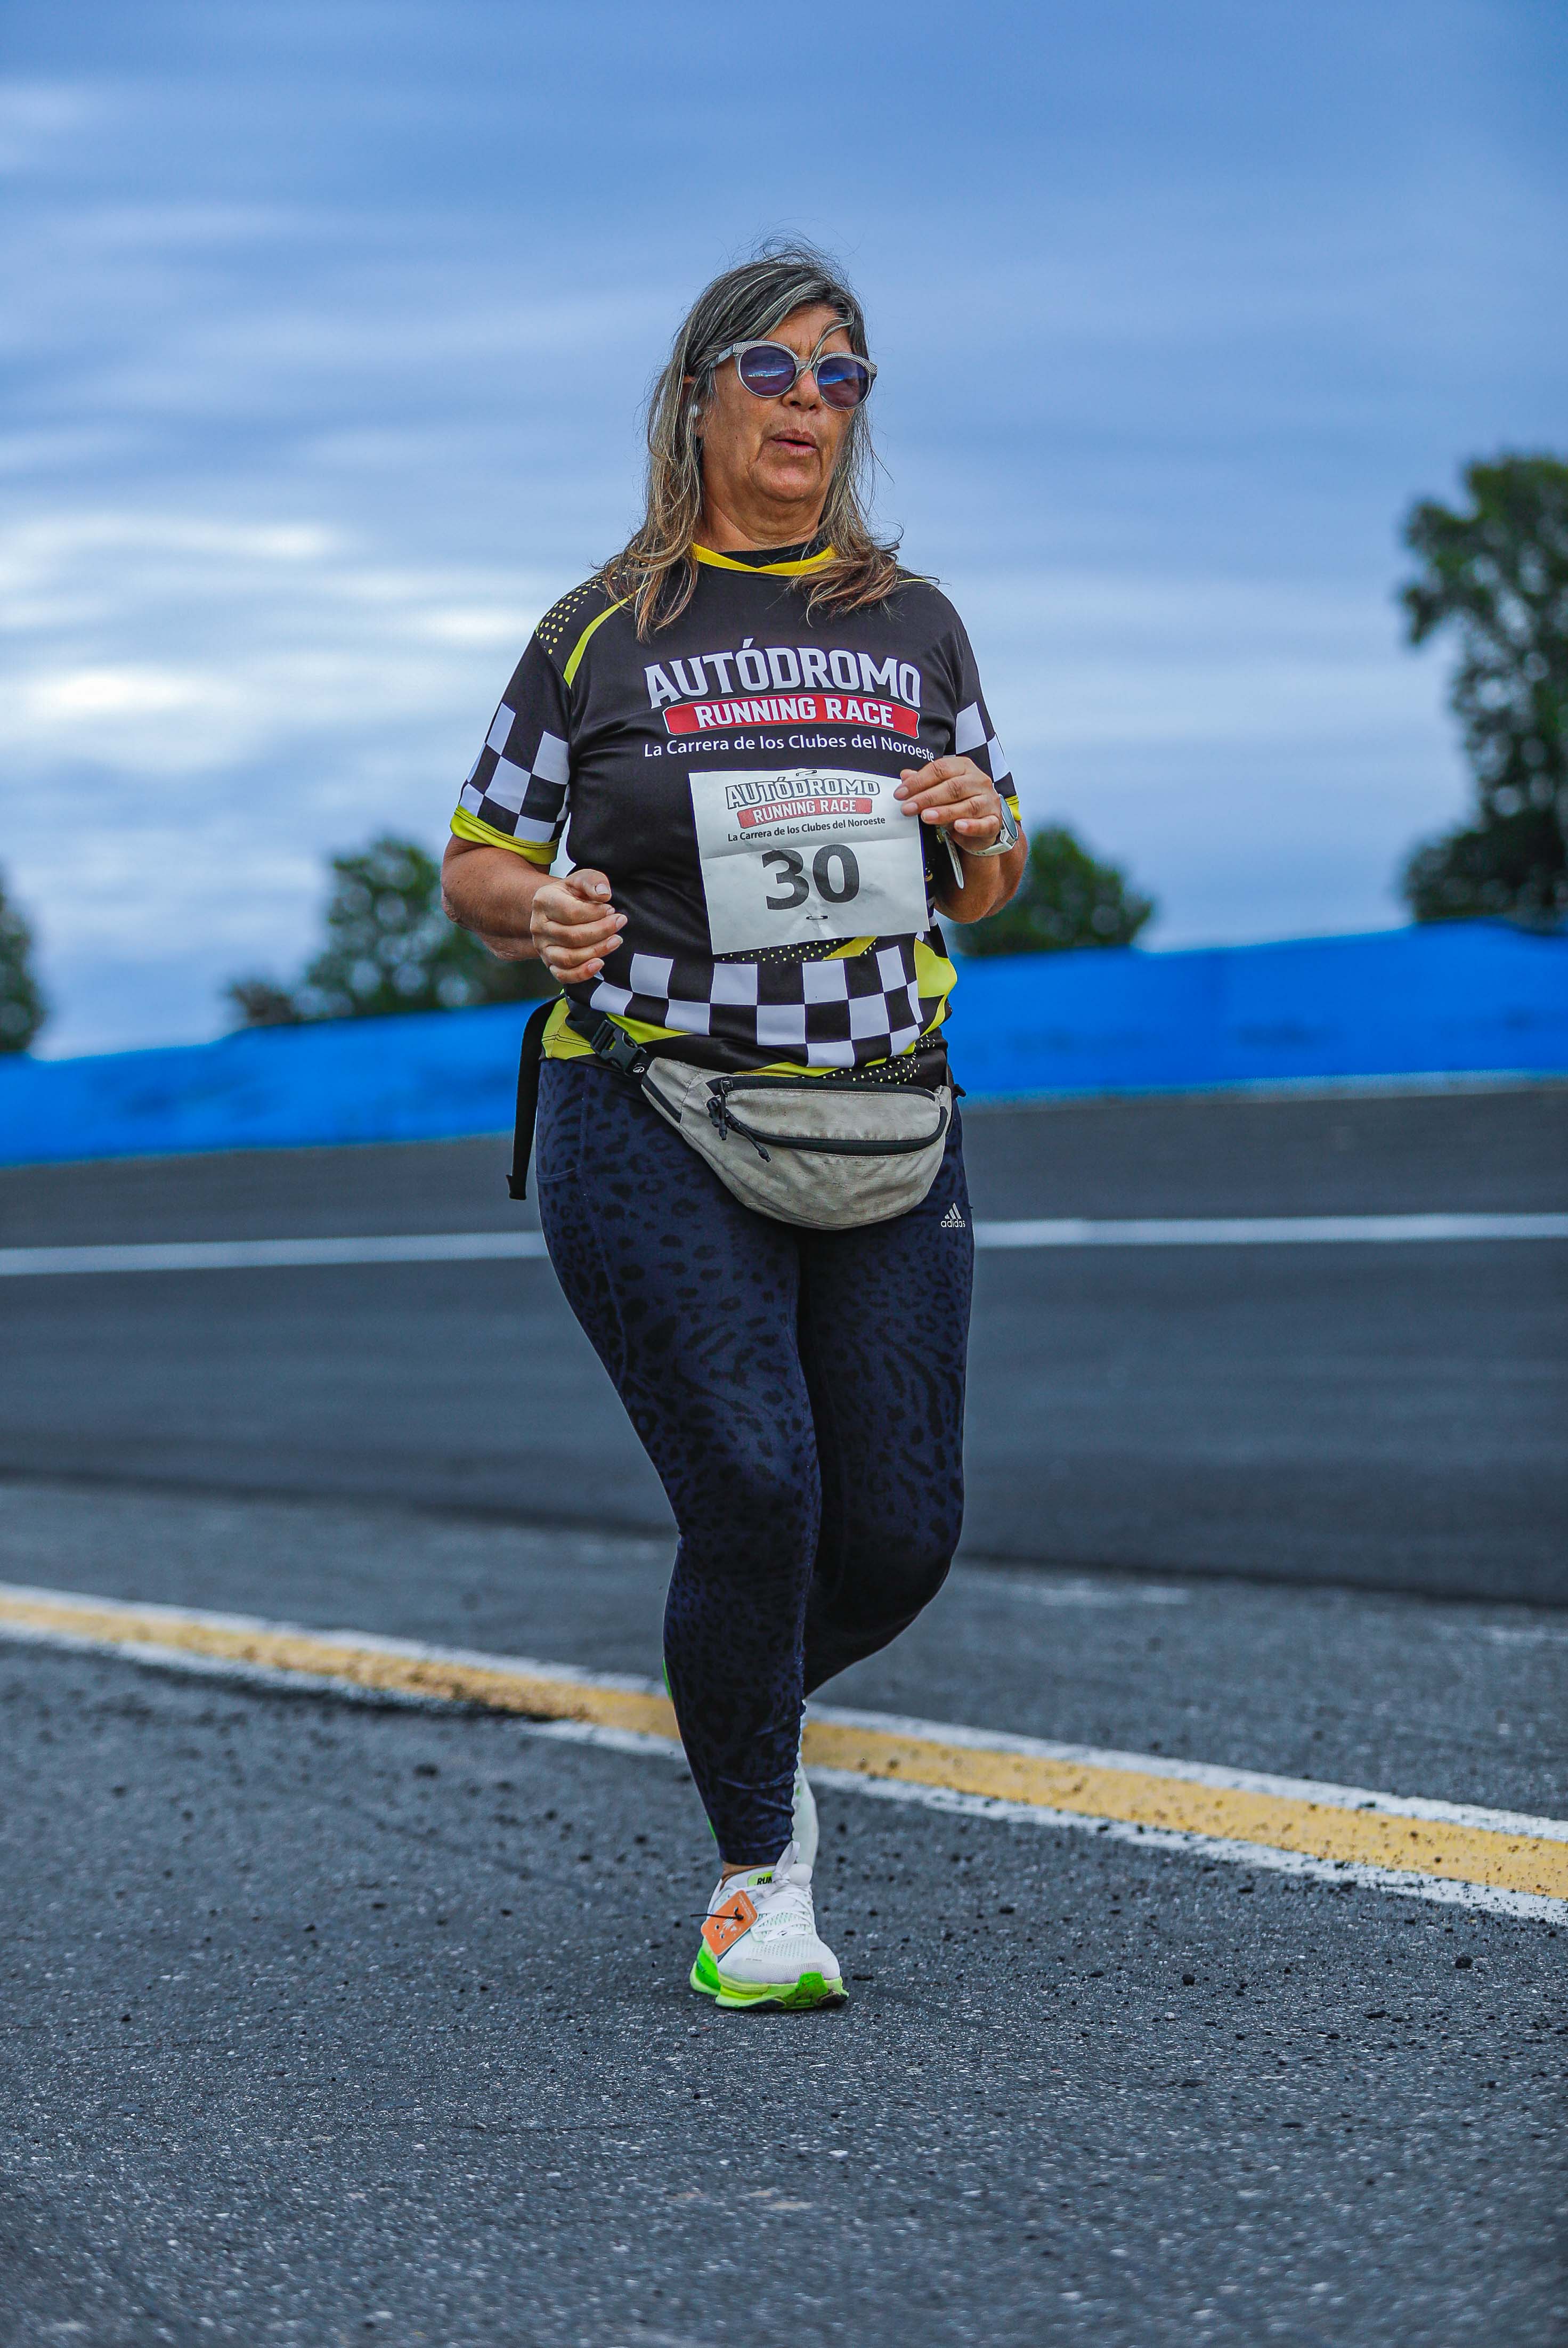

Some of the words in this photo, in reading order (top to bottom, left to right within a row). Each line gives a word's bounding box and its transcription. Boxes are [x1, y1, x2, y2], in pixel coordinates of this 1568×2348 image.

[644, 638, 921, 709] AUTÓDROMO
[694, 698, 816, 729] RUNNING
[823, 697, 894, 728] RACE
[644, 744, 662, 757] La
[667, 740, 729, 754] Carrera
[734, 736, 755, 750] de
[759, 735, 784, 749] los
[789, 734, 847, 749] Clubes
[851, 734, 877, 749] del
[881, 736, 935, 762] Noroeste
[725, 776, 880, 809] AUTÓDROMO
[752, 800, 816, 824] RUNNING
[819, 799, 857, 813] RACE
[728, 833, 738, 842] La
[740, 831, 772, 841] Carrera
[774, 828, 785, 836] de
[787, 826, 800, 834] los
[801, 823, 831, 833] Clubes
[832, 820, 846, 829] del
[848, 817, 885, 827] Noroeste
[761, 844, 860, 910] 30
[940, 1218, 965, 1228] adidas
